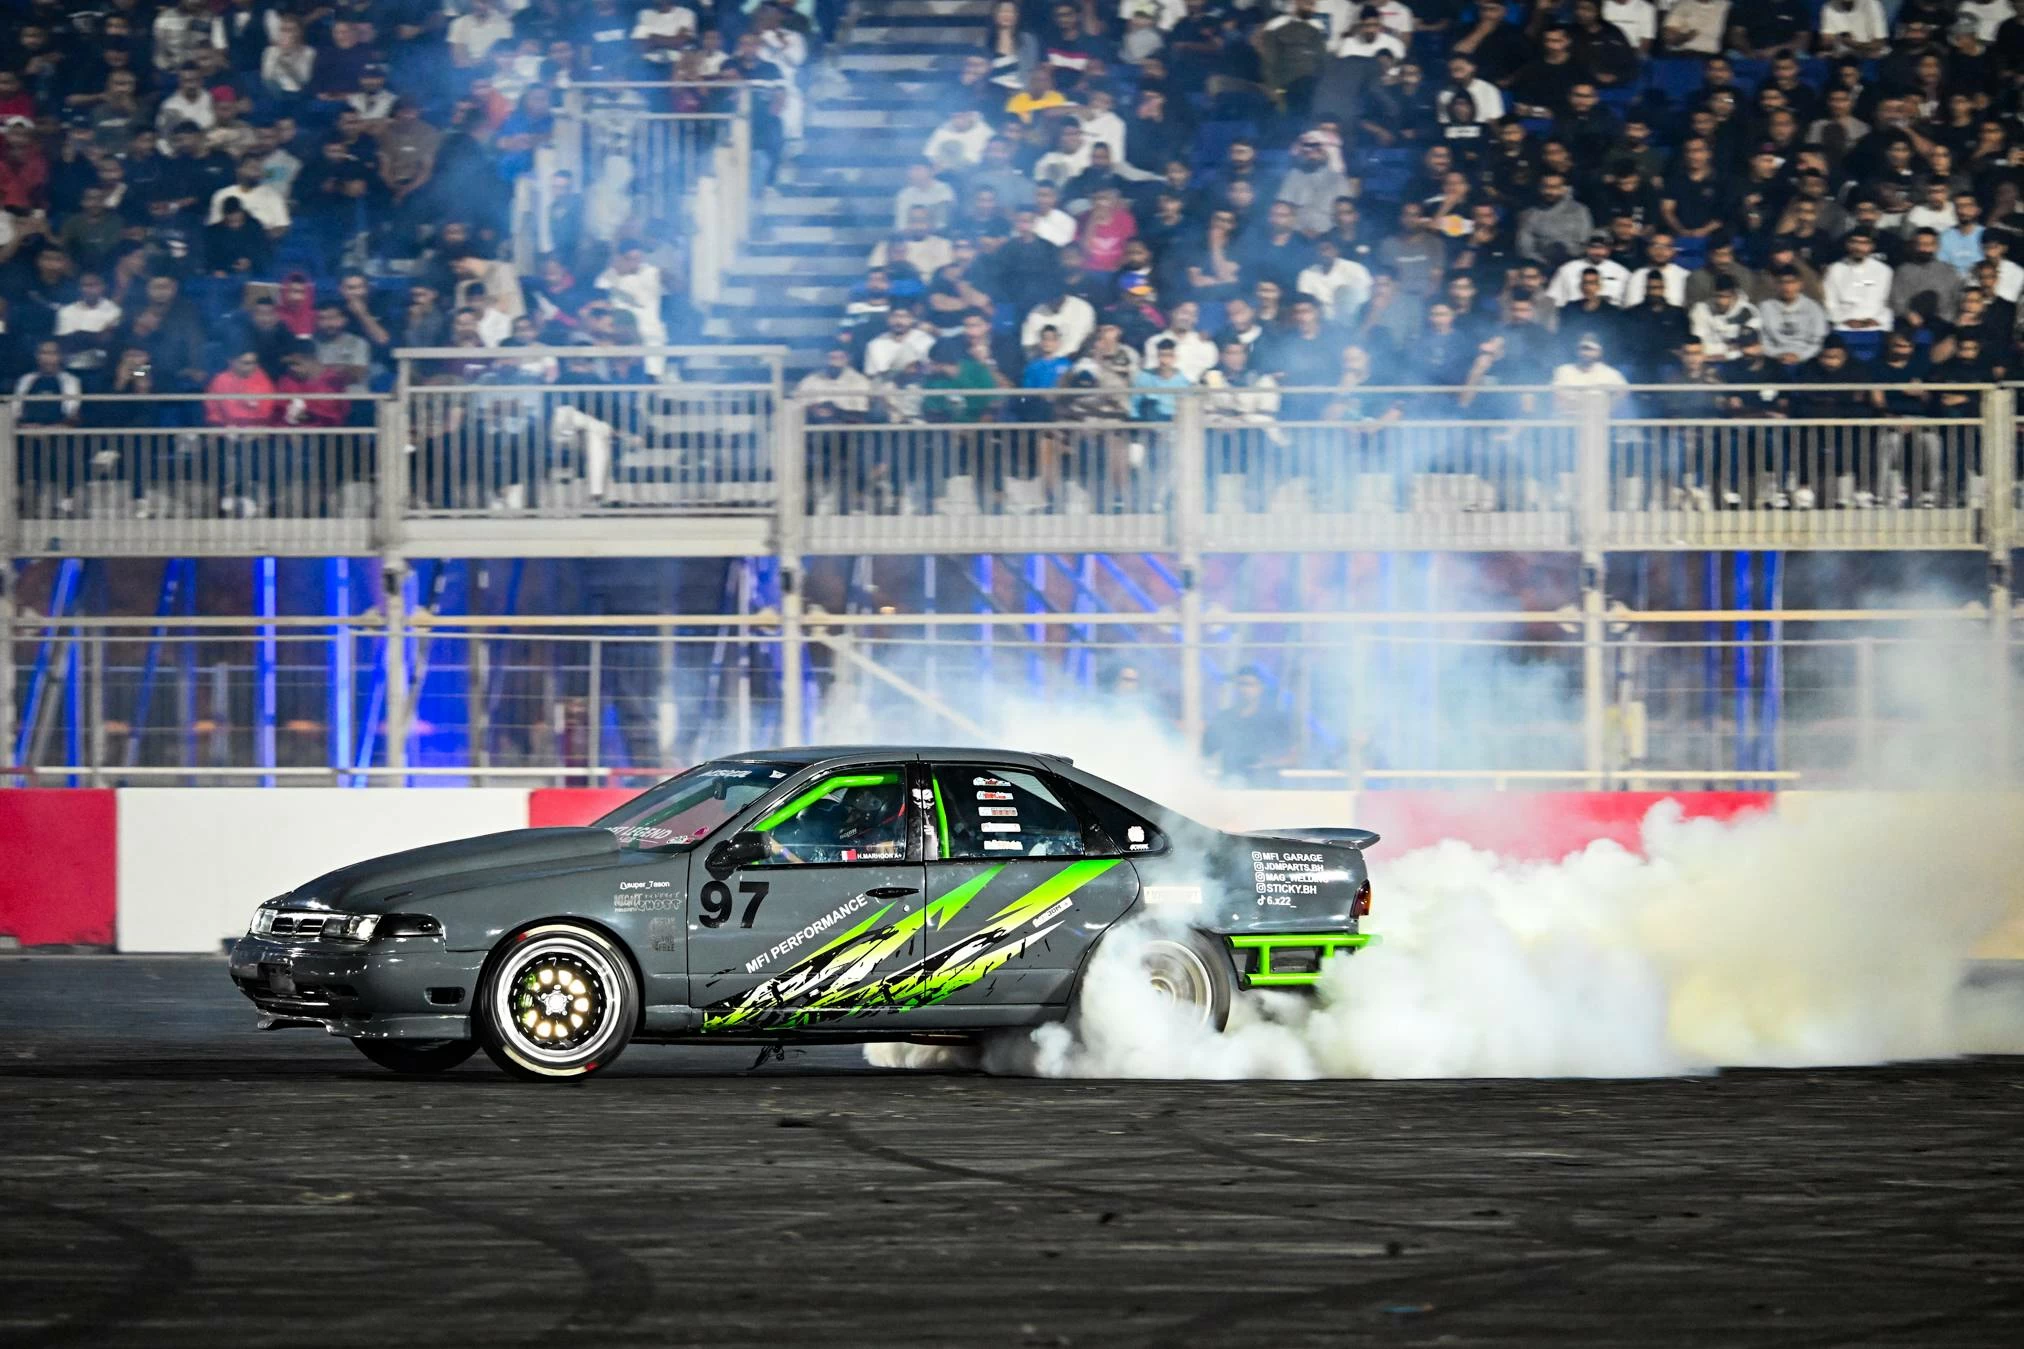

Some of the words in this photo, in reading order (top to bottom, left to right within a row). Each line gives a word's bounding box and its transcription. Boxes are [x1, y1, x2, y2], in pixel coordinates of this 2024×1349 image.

[1262, 852, 1324, 863] MFI_GARAGE
[1264, 862, 1325, 872] JDMPARTS.BH
[1266, 883, 1317, 894] STICKY.BH
[698, 880, 770, 929] 97
[745, 952, 771, 974] MFI
[770, 893, 868, 960] PERFORMANCE
